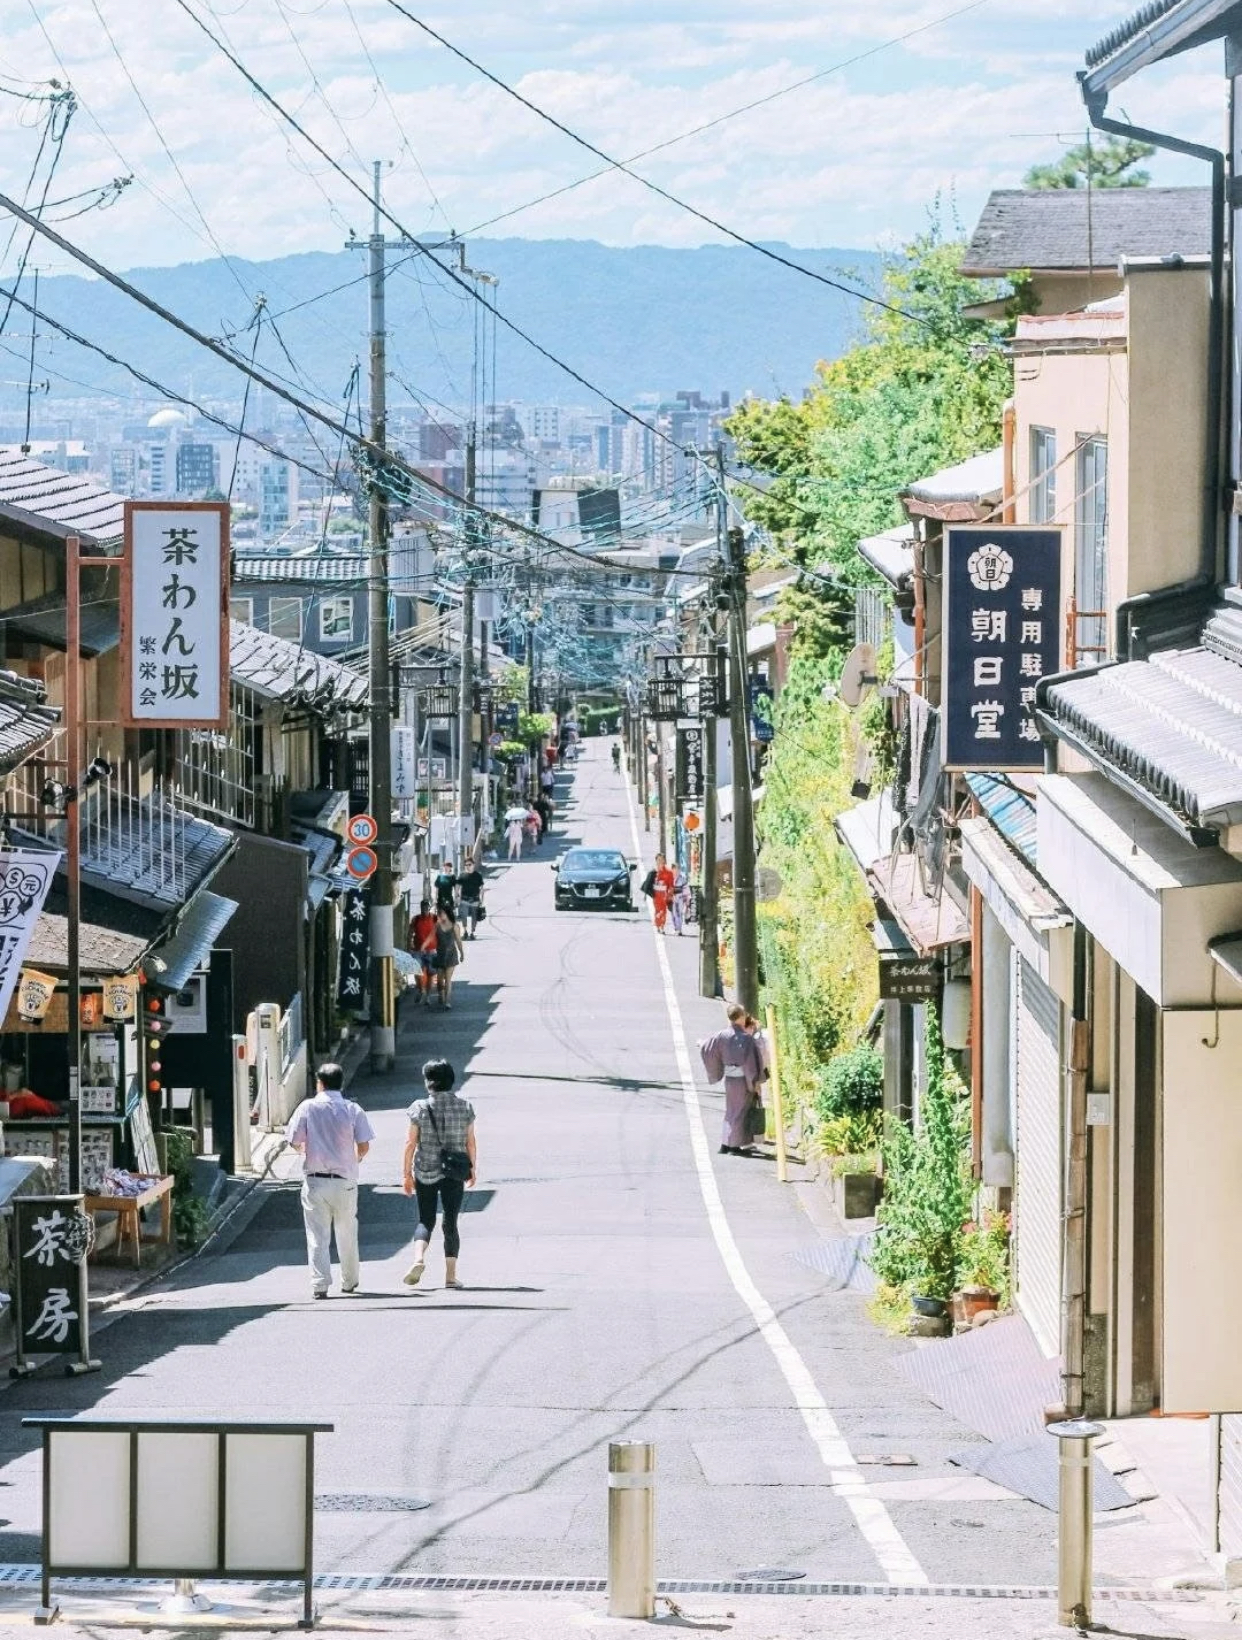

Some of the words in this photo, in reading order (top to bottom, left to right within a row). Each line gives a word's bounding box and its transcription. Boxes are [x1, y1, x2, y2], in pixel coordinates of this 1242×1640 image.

[984, 557, 997, 579] 朝日
[161, 528, 199, 700] 茶わん坂
[139, 636, 157, 706] 繁栄会
[971, 607, 1007, 740] 朝日堂
[354, 824, 370, 837] 30
[25, 880, 36, 891] 元
[343, 896, 366, 995] 茶わん坂
[23, 1210, 78, 1343] 茶房
